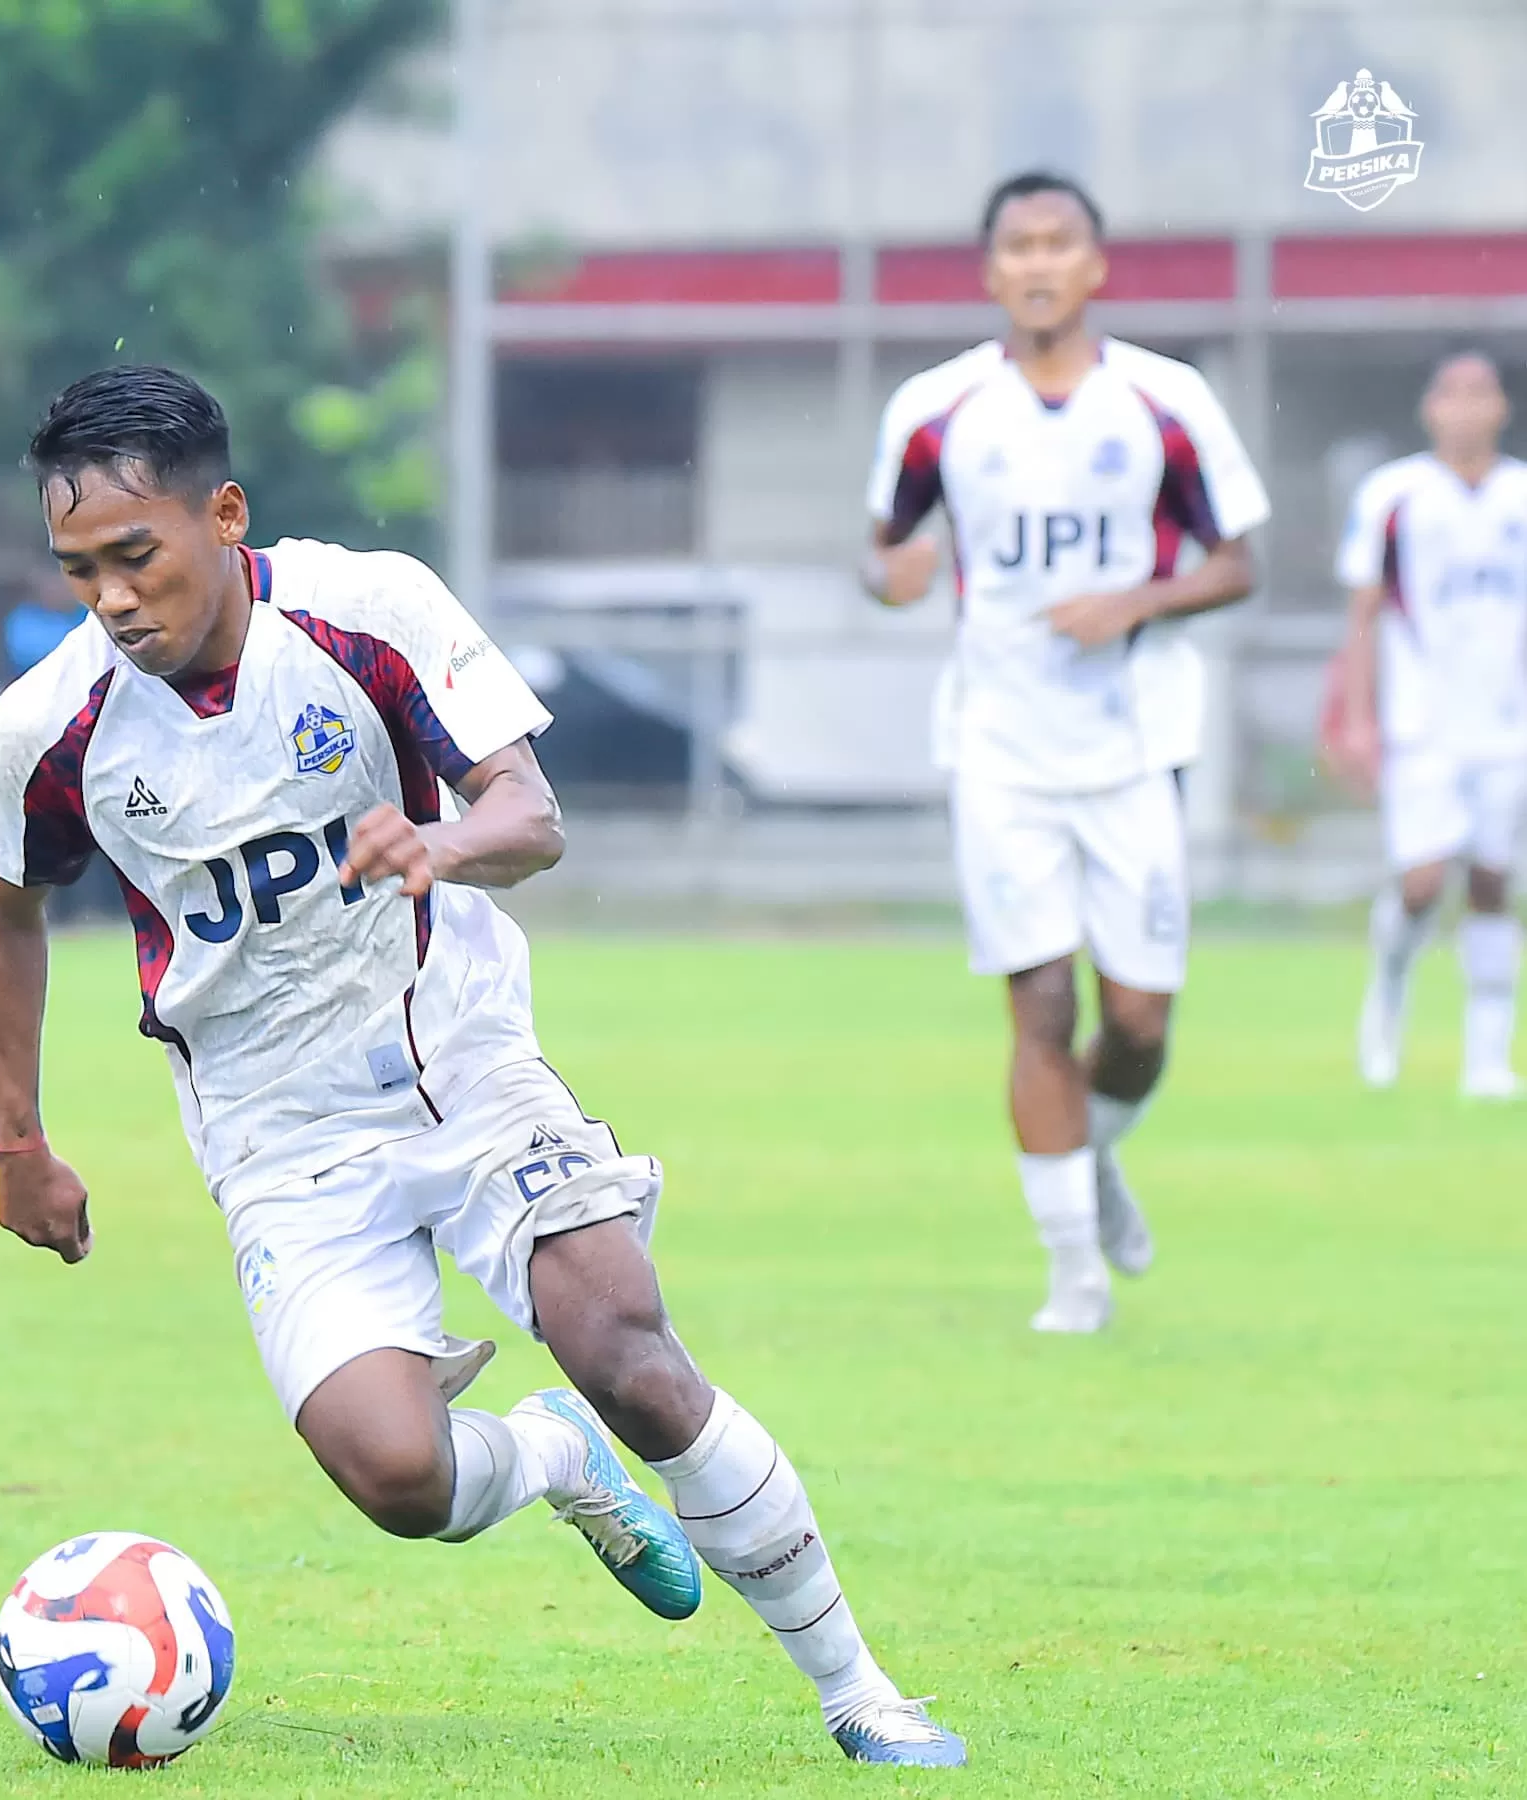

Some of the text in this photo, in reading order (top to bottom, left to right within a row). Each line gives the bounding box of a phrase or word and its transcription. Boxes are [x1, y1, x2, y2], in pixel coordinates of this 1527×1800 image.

[993, 511, 1109, 570] JPI
[304, 738, 348, 767] PERSIKA
[124, 806, 168, 818] amrta
[184, 816, 366, 944] JPI
